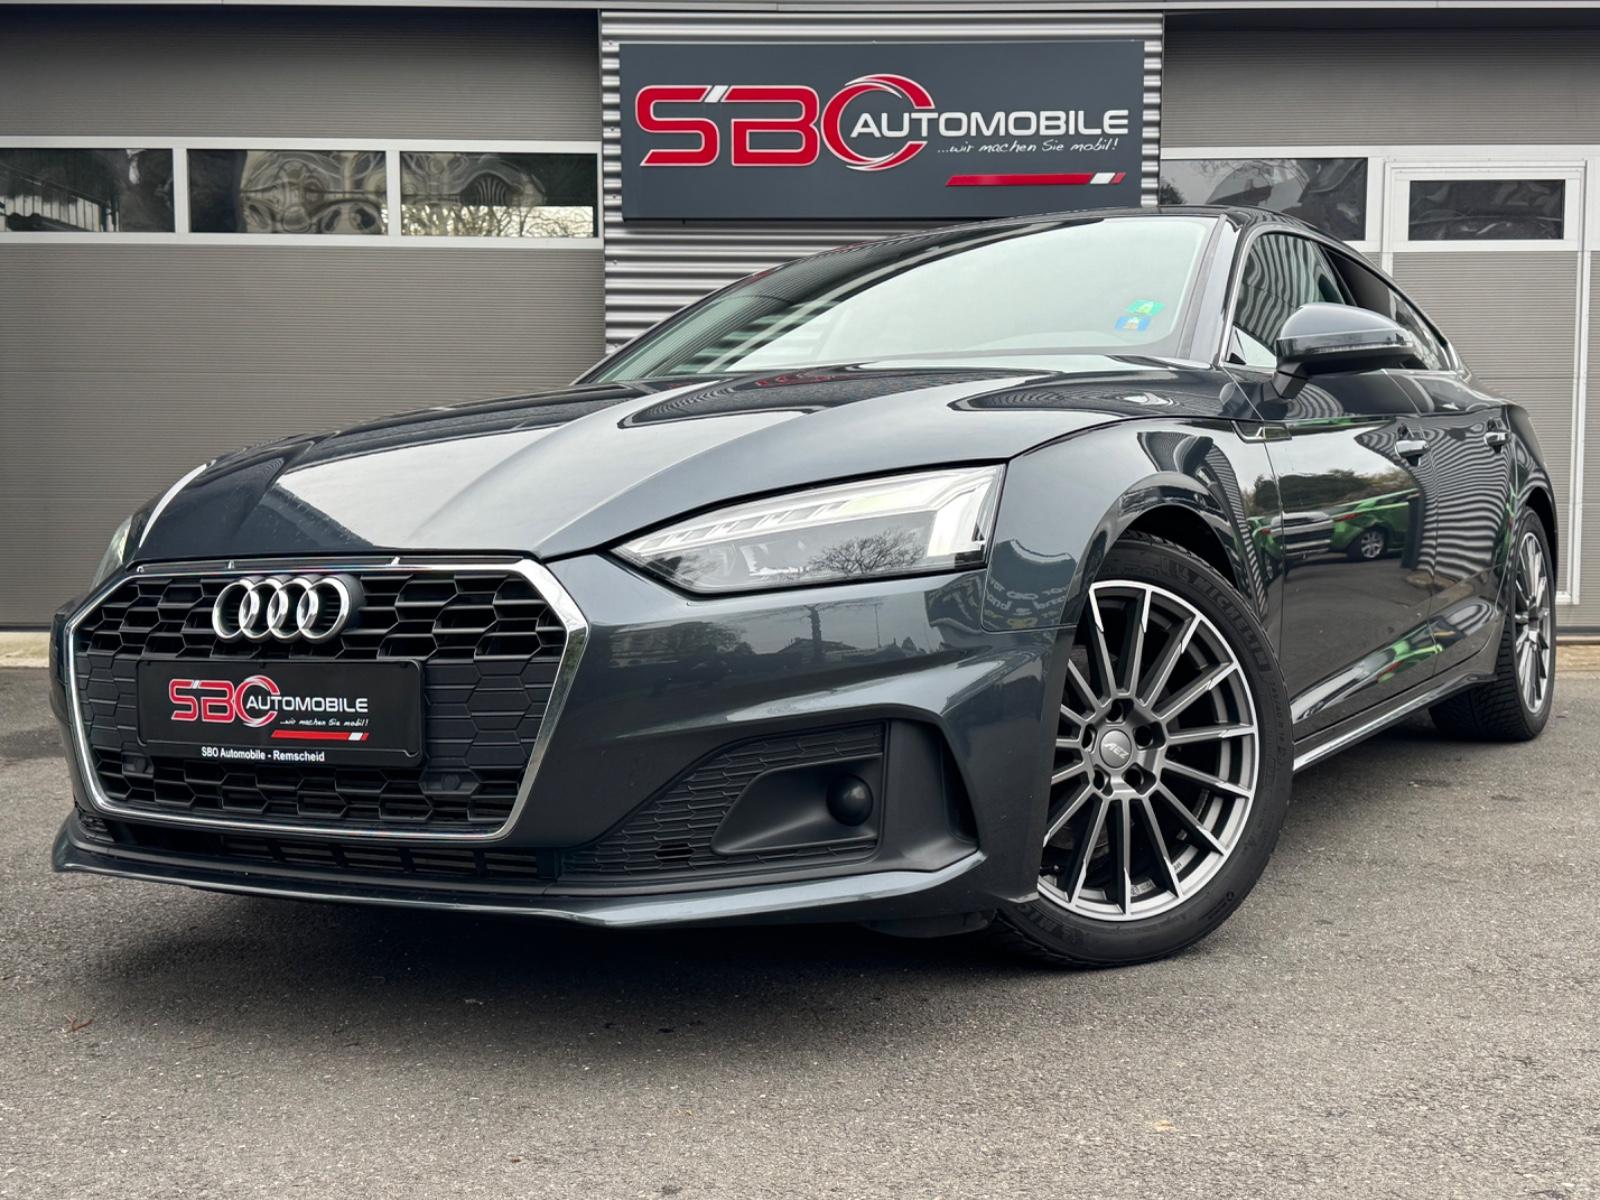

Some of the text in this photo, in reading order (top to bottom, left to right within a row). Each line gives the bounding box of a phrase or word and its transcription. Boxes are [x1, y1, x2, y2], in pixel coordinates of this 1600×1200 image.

[850, 109, 1129, 138] AUTOMOBILE
[978, 139, 1037, 153] machen
[1042, 138, 1065, 152] Sie
[1070, 137, 1119, 152] mobil!
[1193, 574, 1270, 666] MICHELIN
[246, 694, 369, 713] AUTOMOBILE
[201, 746, 219, 758] SBO
[219, 748, 266, 760] Automobile
[272, 749, 326, 763] Remscheid
[1103, 743, 1130, 759] AEZ
